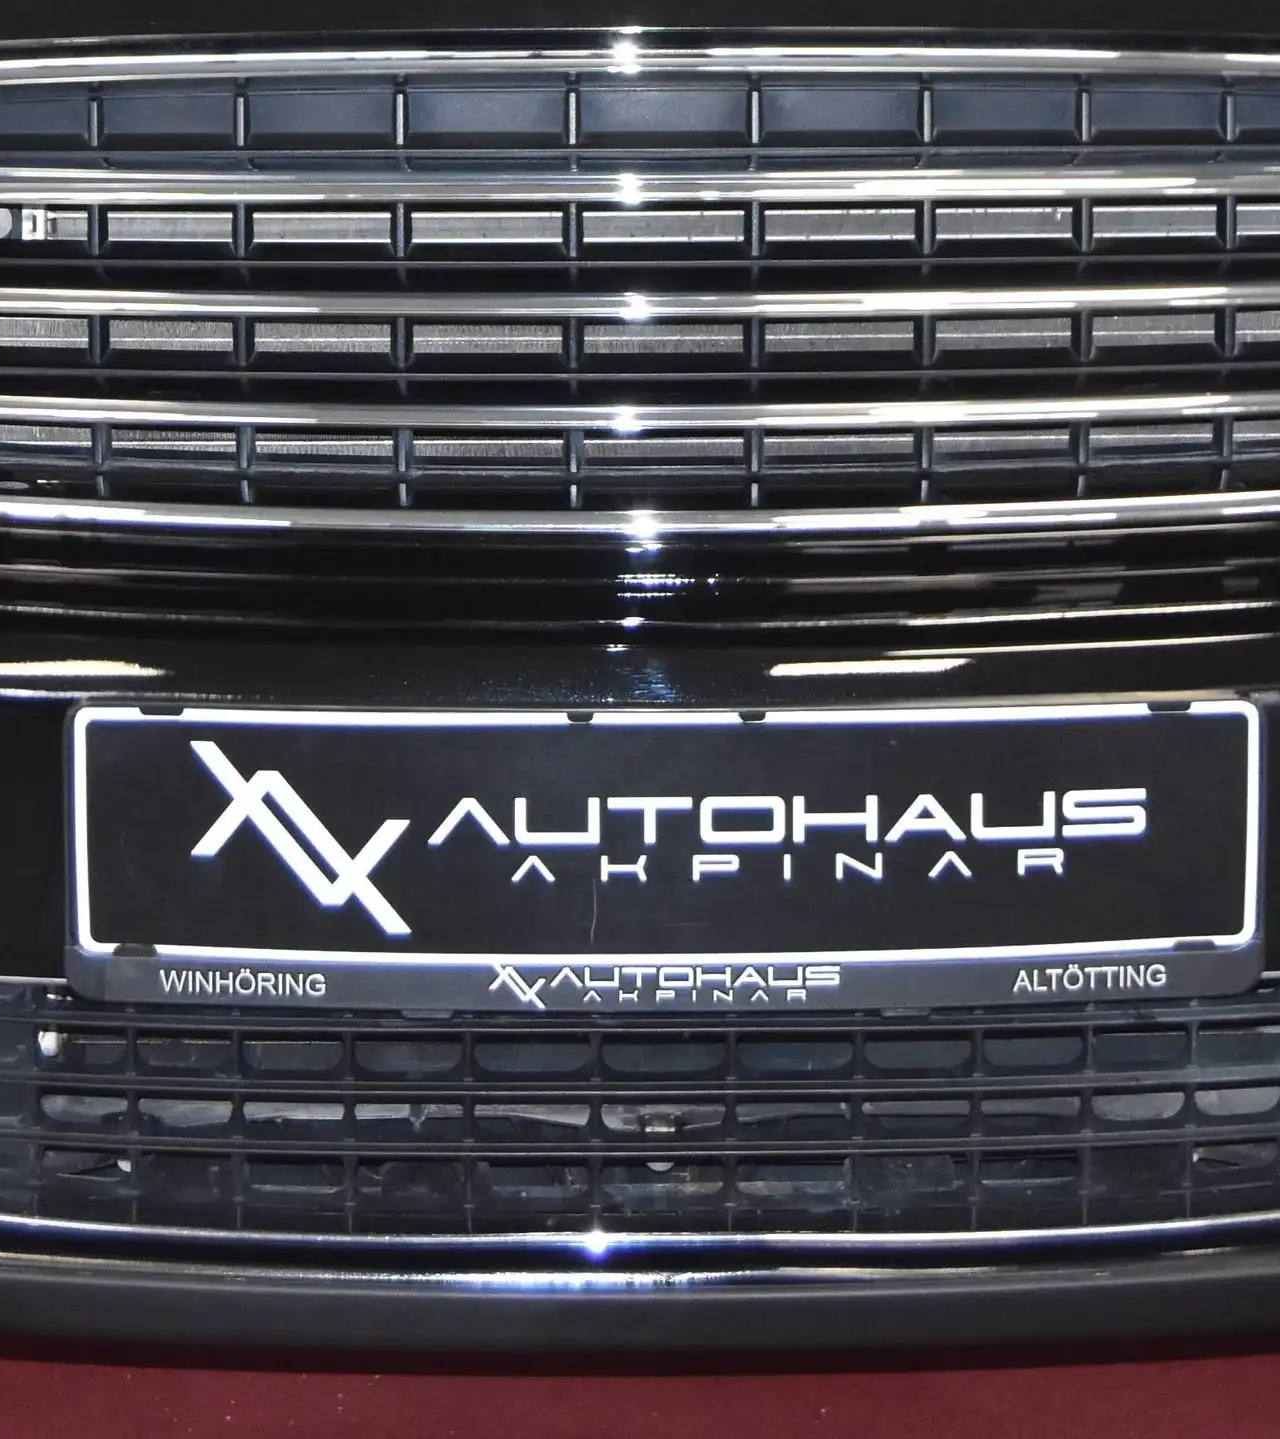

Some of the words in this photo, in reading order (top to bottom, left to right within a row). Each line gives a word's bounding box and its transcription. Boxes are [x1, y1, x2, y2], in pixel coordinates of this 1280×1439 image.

[427, 787, 1148, 846] AUTOHAUS
[510, 847, 1065, 882] AKPINAR
[158, 967, 327, 997] WINHÖRING
[549, 964, 842, 988] AUTOHAUS
[1012, 963, 1168, 993] ALTÖTTING
[582, 988, 808, 1003] AKPINAR
